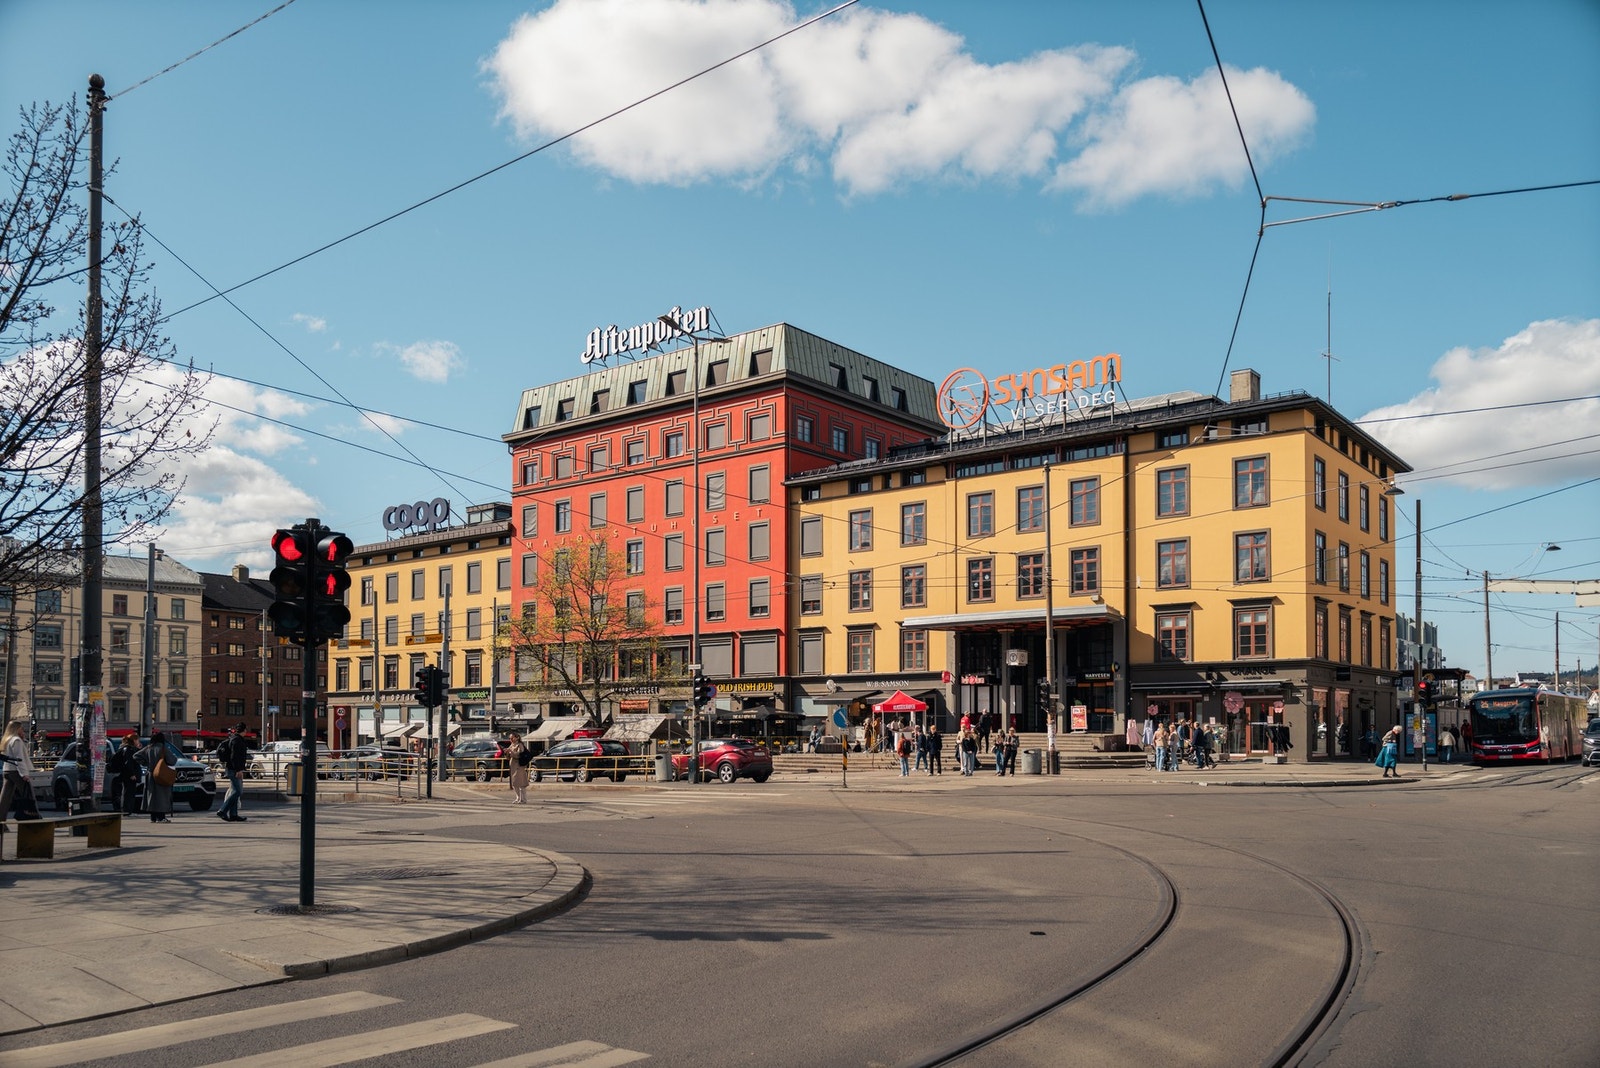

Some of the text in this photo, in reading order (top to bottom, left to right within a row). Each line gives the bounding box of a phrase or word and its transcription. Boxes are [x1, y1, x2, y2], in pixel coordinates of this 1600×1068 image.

[581, 306, 709, 364] Aftenposten
[1011, 391, 1116, 421] VI SER DEG
[717, 683, 733, 692] OLD
[758, 682, 774, 691] PUB
